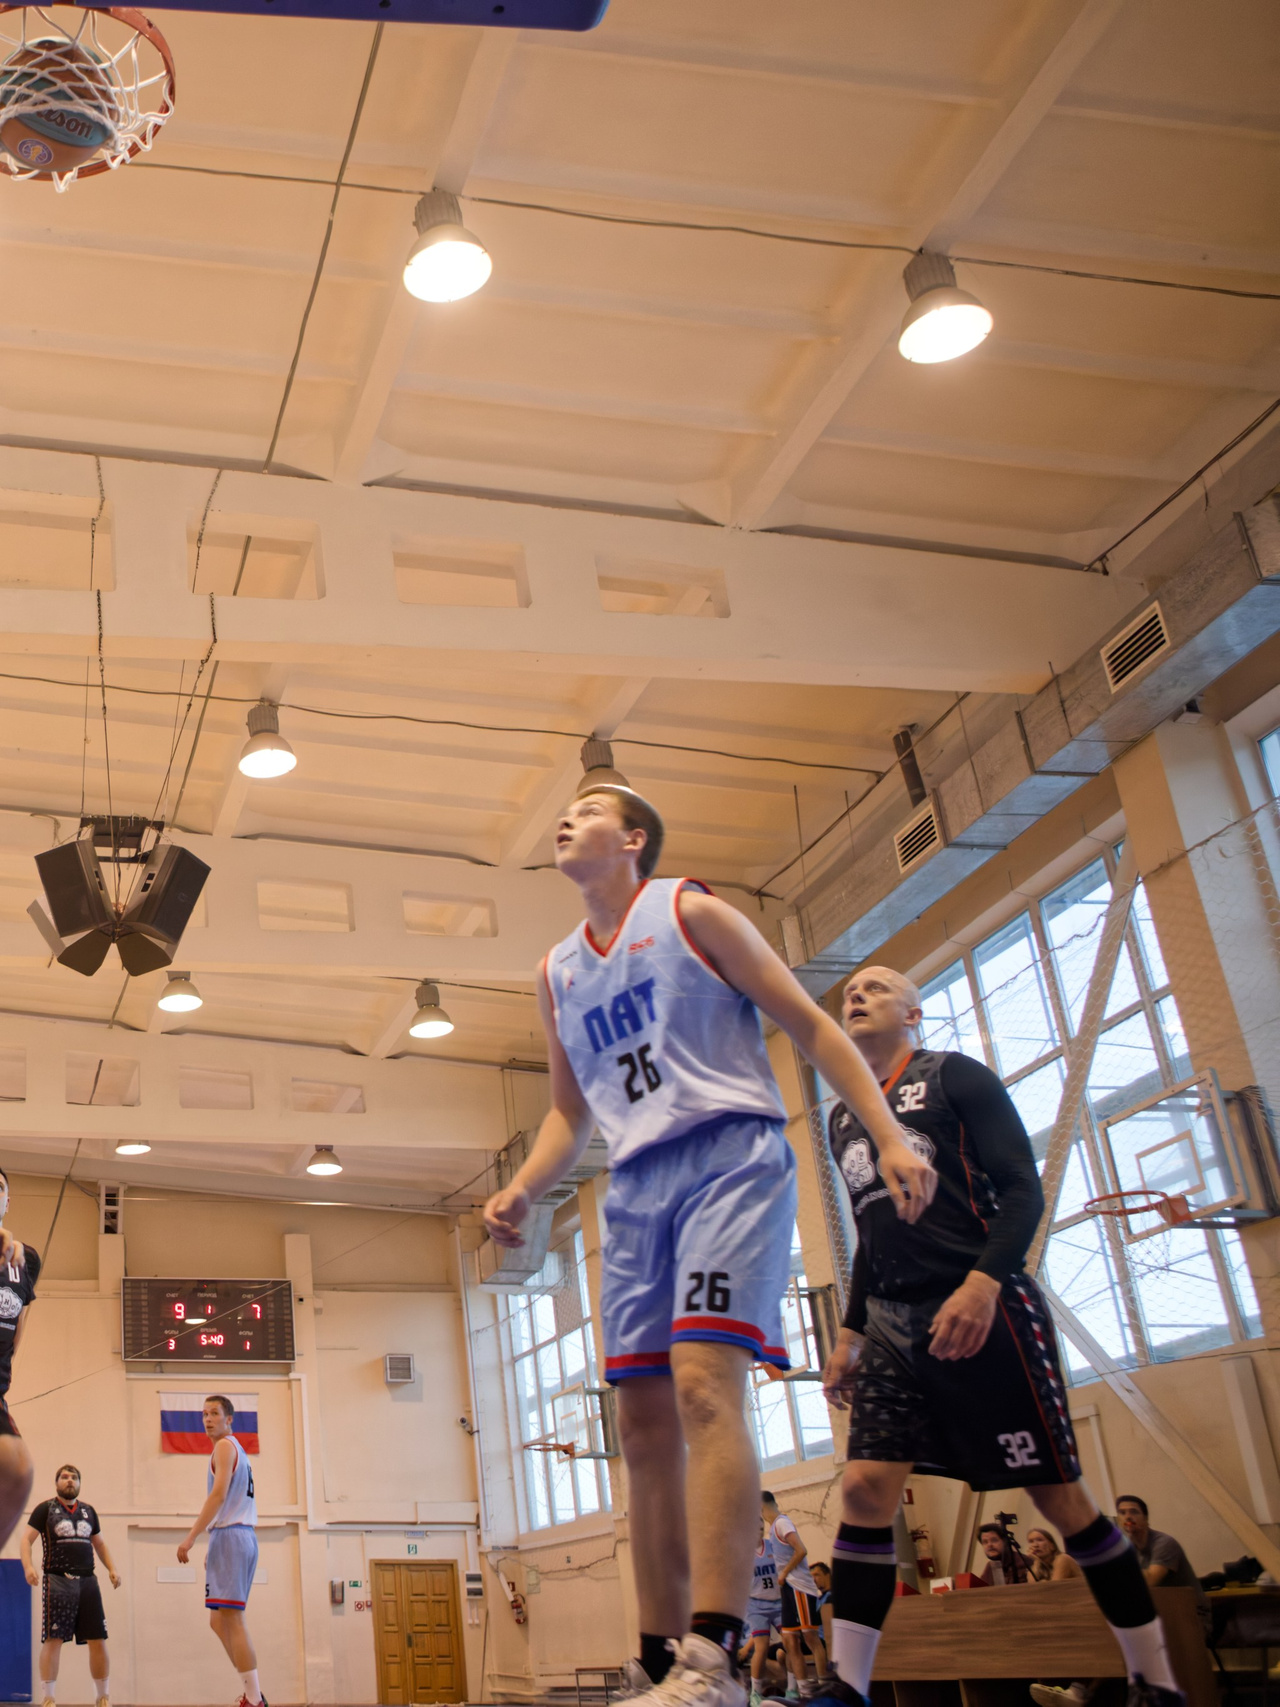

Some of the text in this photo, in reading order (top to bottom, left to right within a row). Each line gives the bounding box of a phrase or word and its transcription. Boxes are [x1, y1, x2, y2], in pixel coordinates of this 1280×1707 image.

[583, 977, 656, 1054] ПАТ
[617, 1042, 662, 1104] 26
[896, 1081, 928, 1114] 32
[684, 1271, 731, 1313] 26
[174, 1303, 185, 1319] 9
[206, 1304, 212, 1314] 1
[252, 1304, 261, 1319] 7
[168, 1338, 176, 1350] 3
[246, 1340, 251, 1351] 1
[997, 1430, 1041, 1469] 32
[81, 1508, 89, 1519] 5
[762, 1577, 775, 1590] 33
